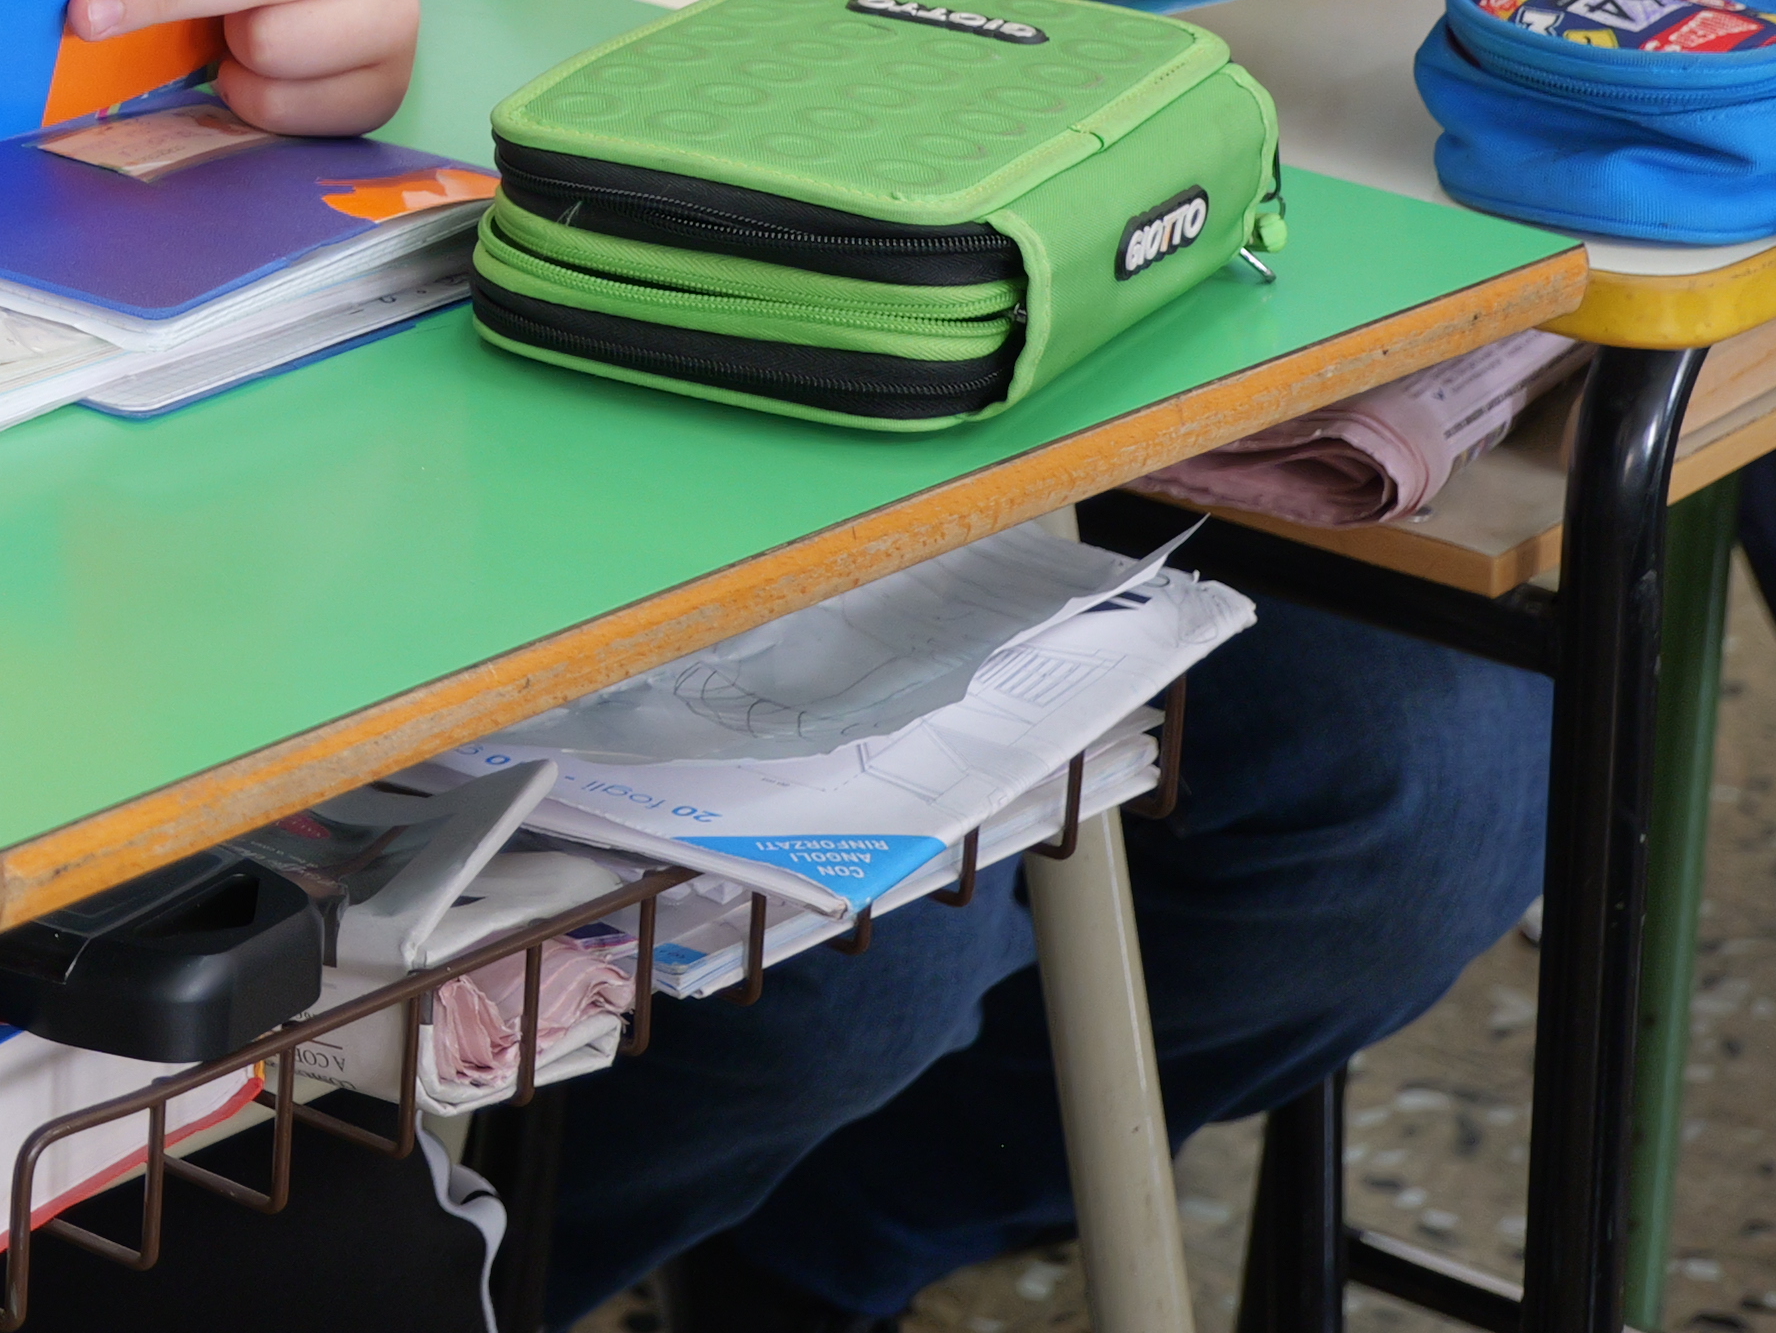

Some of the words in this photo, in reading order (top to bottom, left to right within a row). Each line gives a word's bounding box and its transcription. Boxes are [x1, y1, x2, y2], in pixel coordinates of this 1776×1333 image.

[1125, 197, 1207, 271] GIOTTO
[581, 779, 666, 810] fogli
[671, 804, 723, 825] 20
[756, 840, 889, 852] RINFORZATI
[790, 852, 872, 865] ANGOLI
[817, 865, 866, 880] CON
